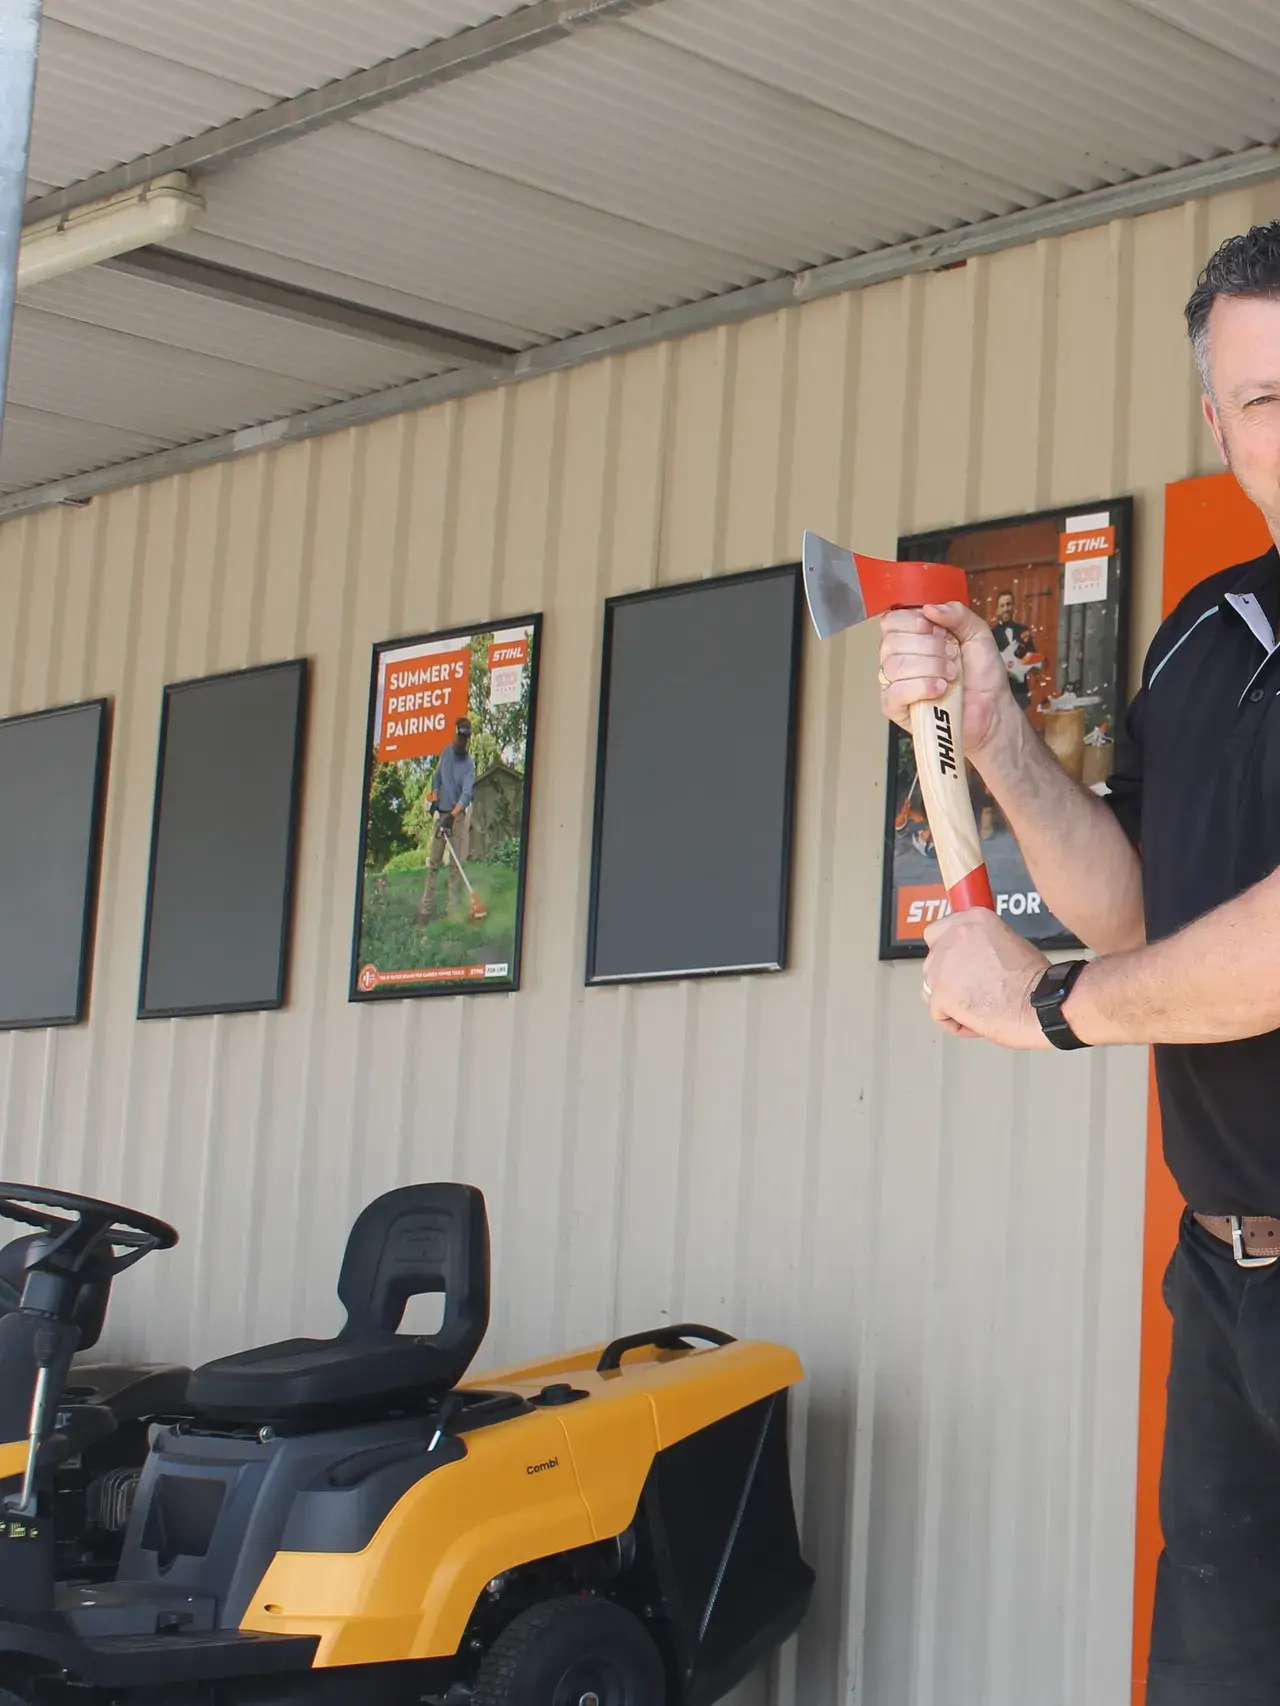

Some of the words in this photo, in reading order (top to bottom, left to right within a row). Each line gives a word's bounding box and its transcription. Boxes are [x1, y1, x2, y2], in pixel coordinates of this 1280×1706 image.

[1065, 535, 1109, 555] STIHL
[491, 646, 524, 662] STIHL
[389, 661, 464, 690] SUMMER'S
[388, 687, 452, 715] PERFECT
[386, 713, 446, 738] PAIRING
[933, 705, 957, 775] STIHL
[906, 899, 952, 923] STI
[996, 892, 1041, 916] FOR
[526, 1456, 559, 1475] Combi
